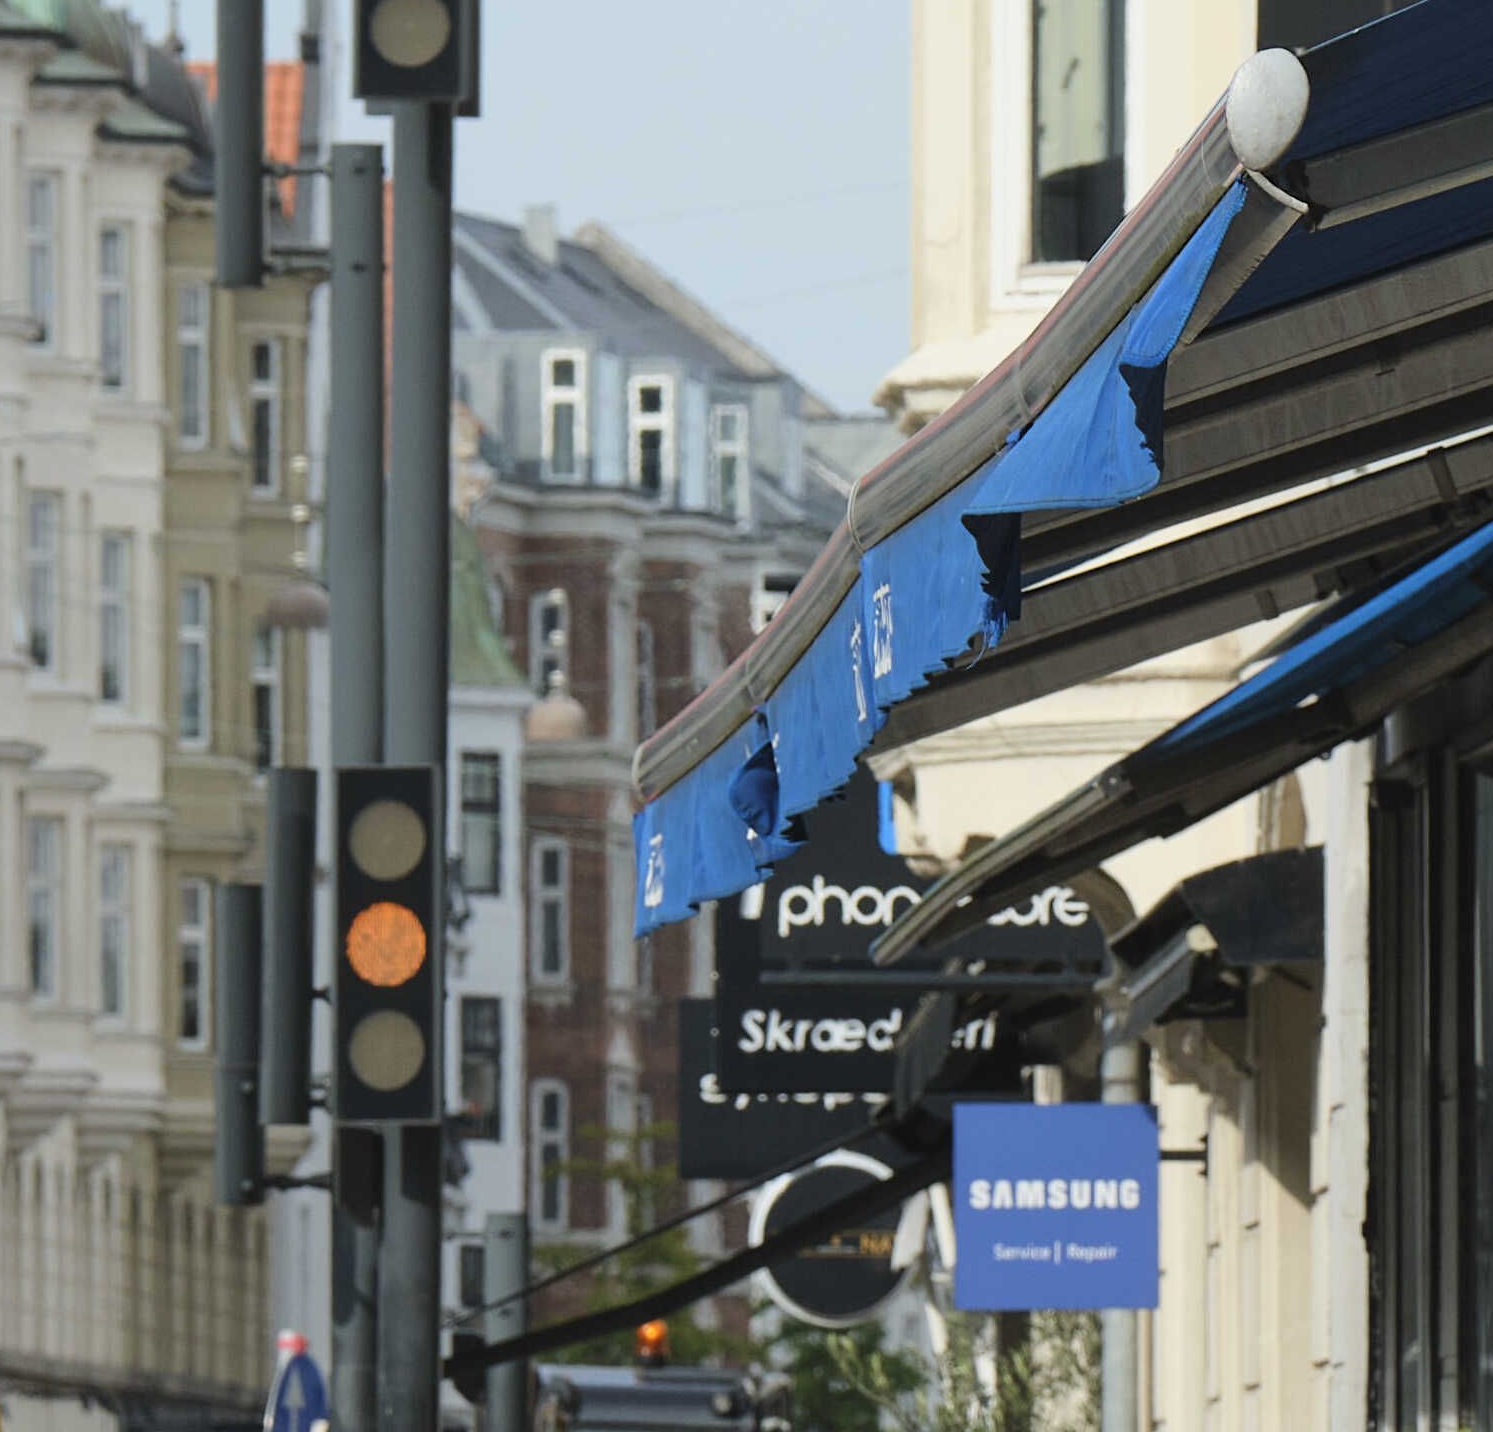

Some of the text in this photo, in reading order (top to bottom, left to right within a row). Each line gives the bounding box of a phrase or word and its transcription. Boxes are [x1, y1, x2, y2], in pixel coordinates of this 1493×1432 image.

[969, 1179, 1140, 1210] SAMSUNG
[993, 1242, 1052, 1261] Service
[1067, 1242, 1118, 1263] Repair
